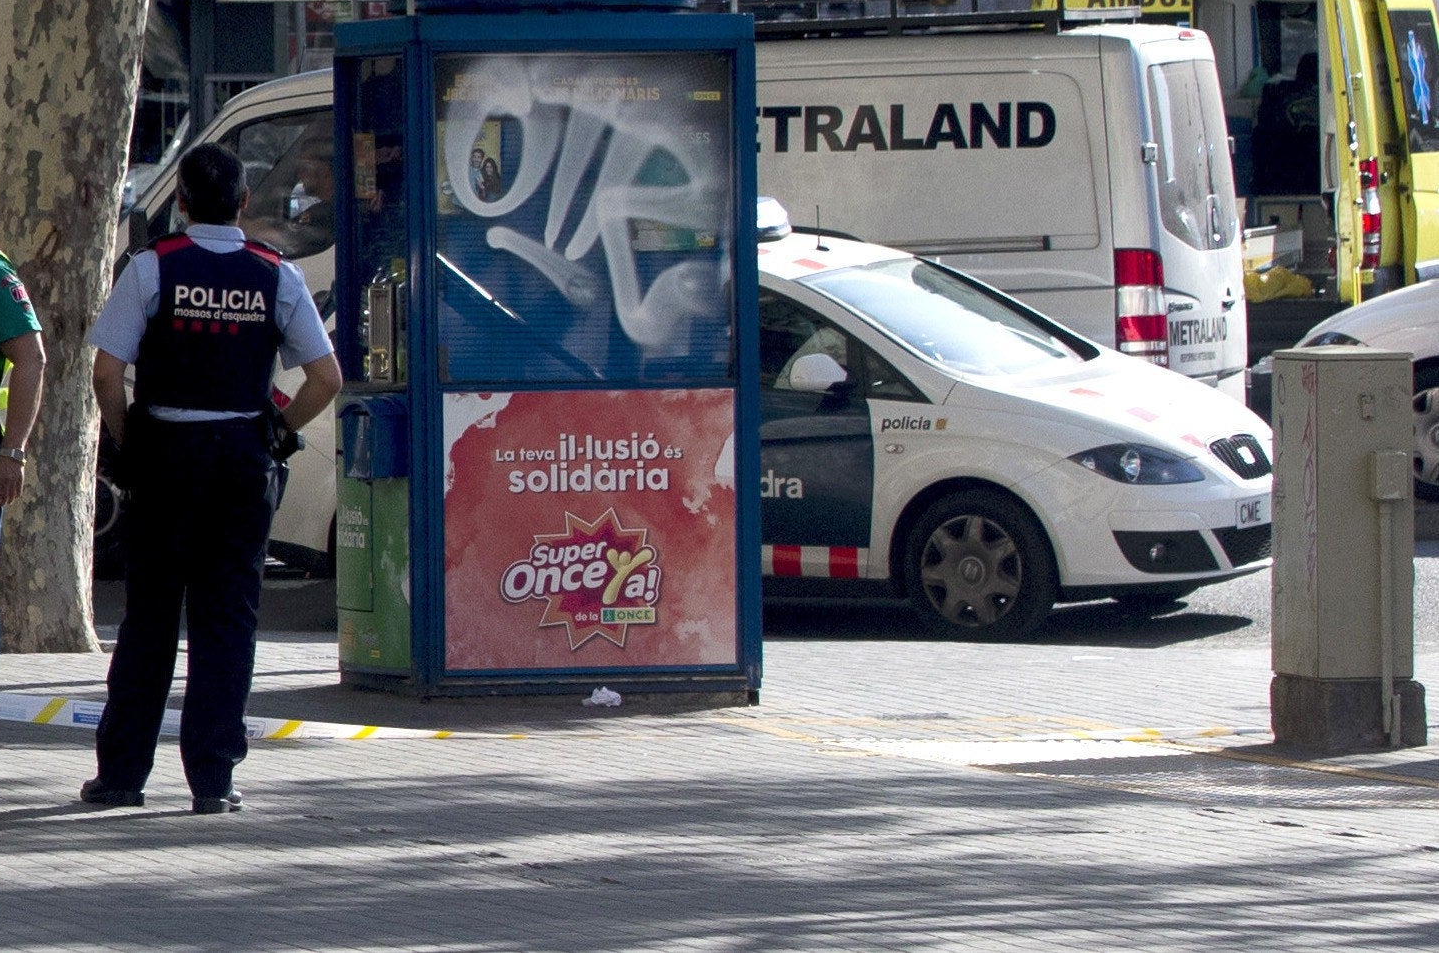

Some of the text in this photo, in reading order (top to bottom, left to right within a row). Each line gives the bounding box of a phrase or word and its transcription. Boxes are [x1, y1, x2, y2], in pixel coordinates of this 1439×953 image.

[756, 100, 1057, 153] TRALAND
[174, 285, 266, 311] POLICIA
[174, 308, 212, 319] mossos
[1168, 316, 1228, 347] METRALAND
[496, 449, 515, 462] La
[520, 448, 555, 461] teva
[664, 446, 683, 460] és
[509, 461, 669, 493] solidària
[532, 541, 607, 567] Super
[504, 561, 608, 599] Once
[575, 609, 651, 621] de la ONCE
